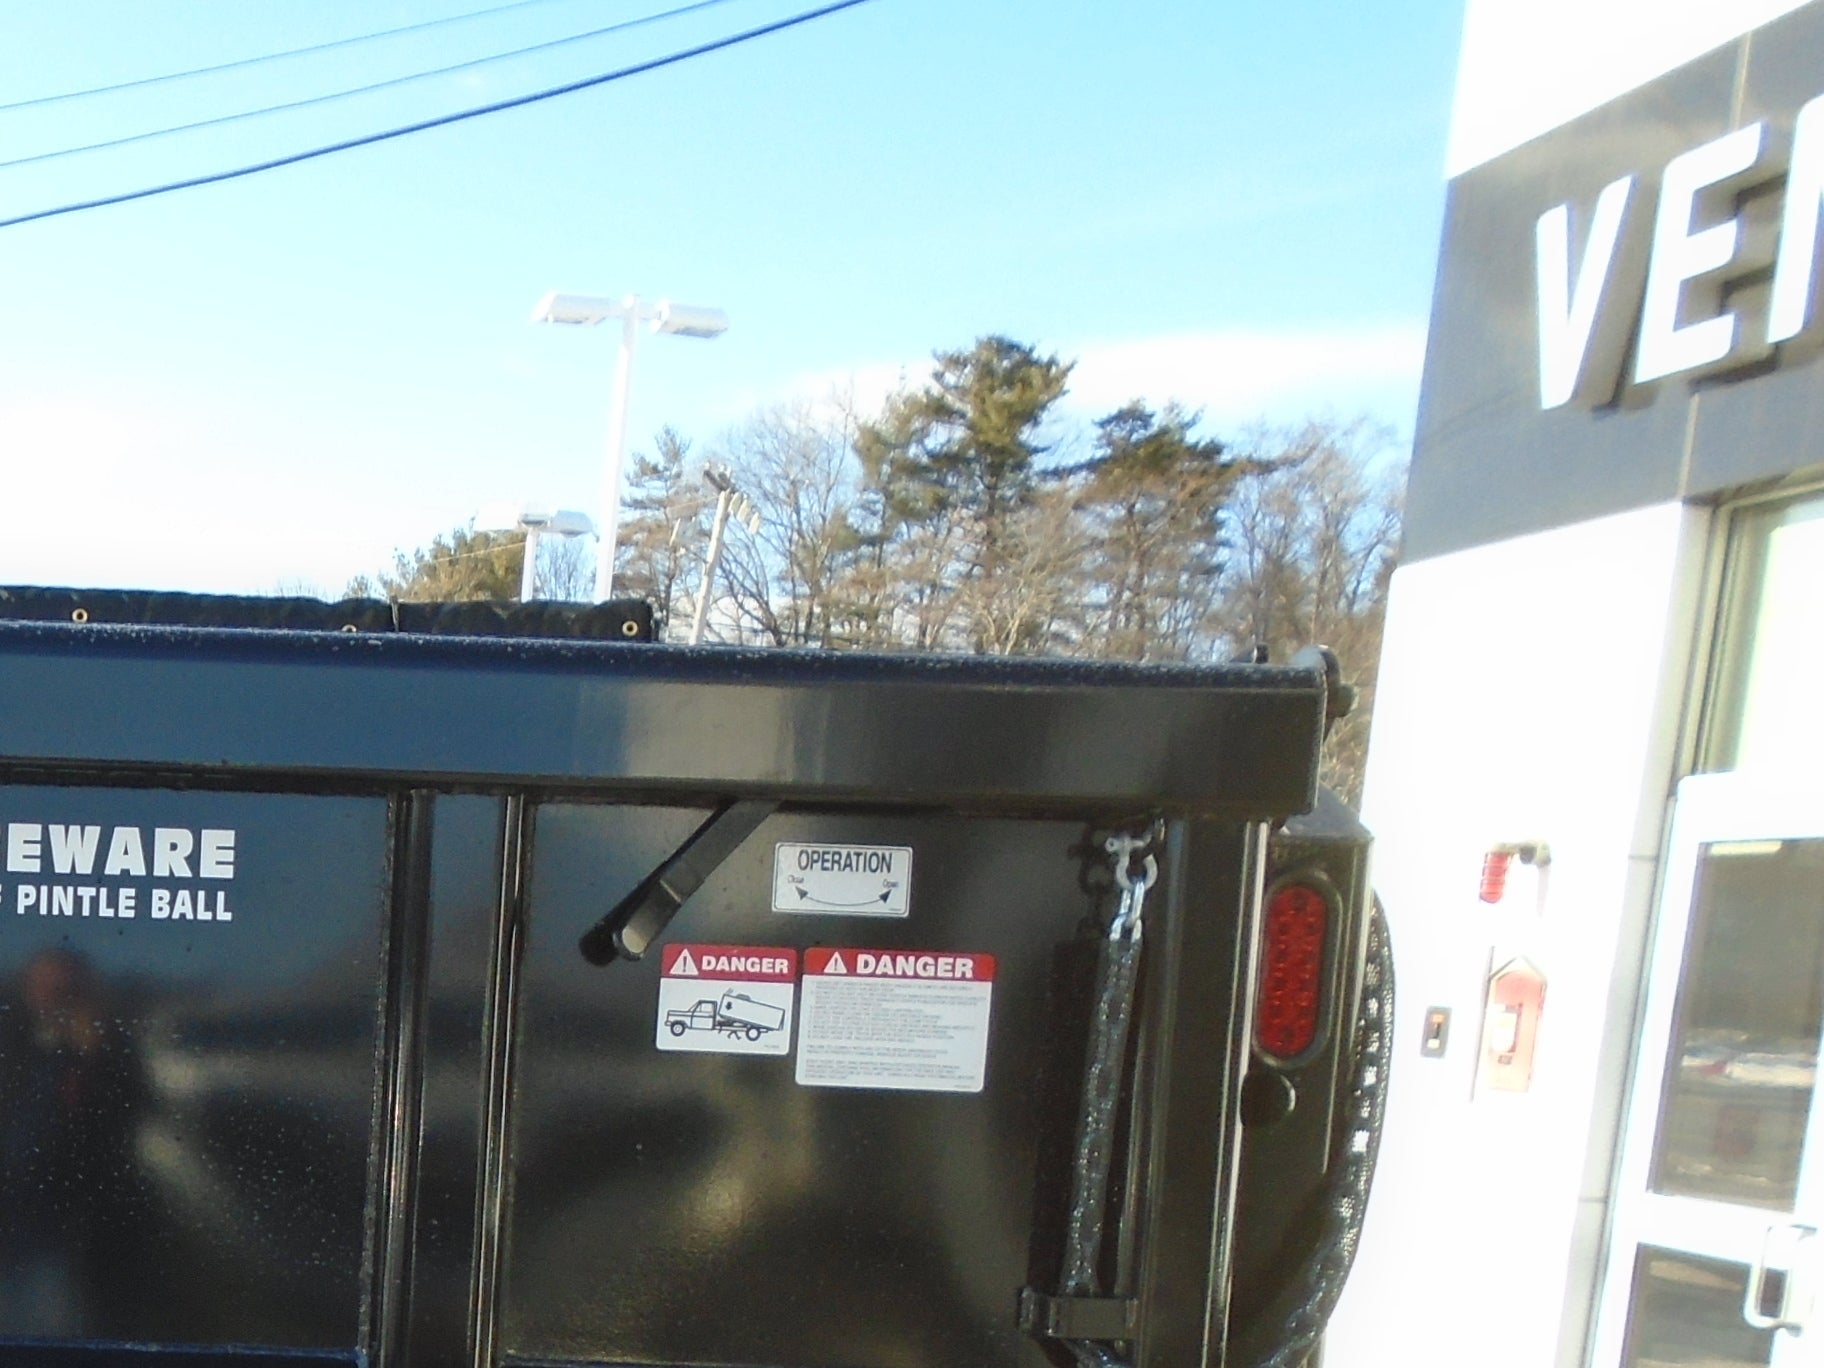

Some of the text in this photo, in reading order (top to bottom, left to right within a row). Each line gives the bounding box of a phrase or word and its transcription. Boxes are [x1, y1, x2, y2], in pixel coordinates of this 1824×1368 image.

[797, 848, 893, 874] OPERATION
[16, 884, 137, 918] PINTLE
[151, 888, 233, 922] BALL
[700, 954, 789, 975] DANGER
[856, 953, 974, 979] DANGER
